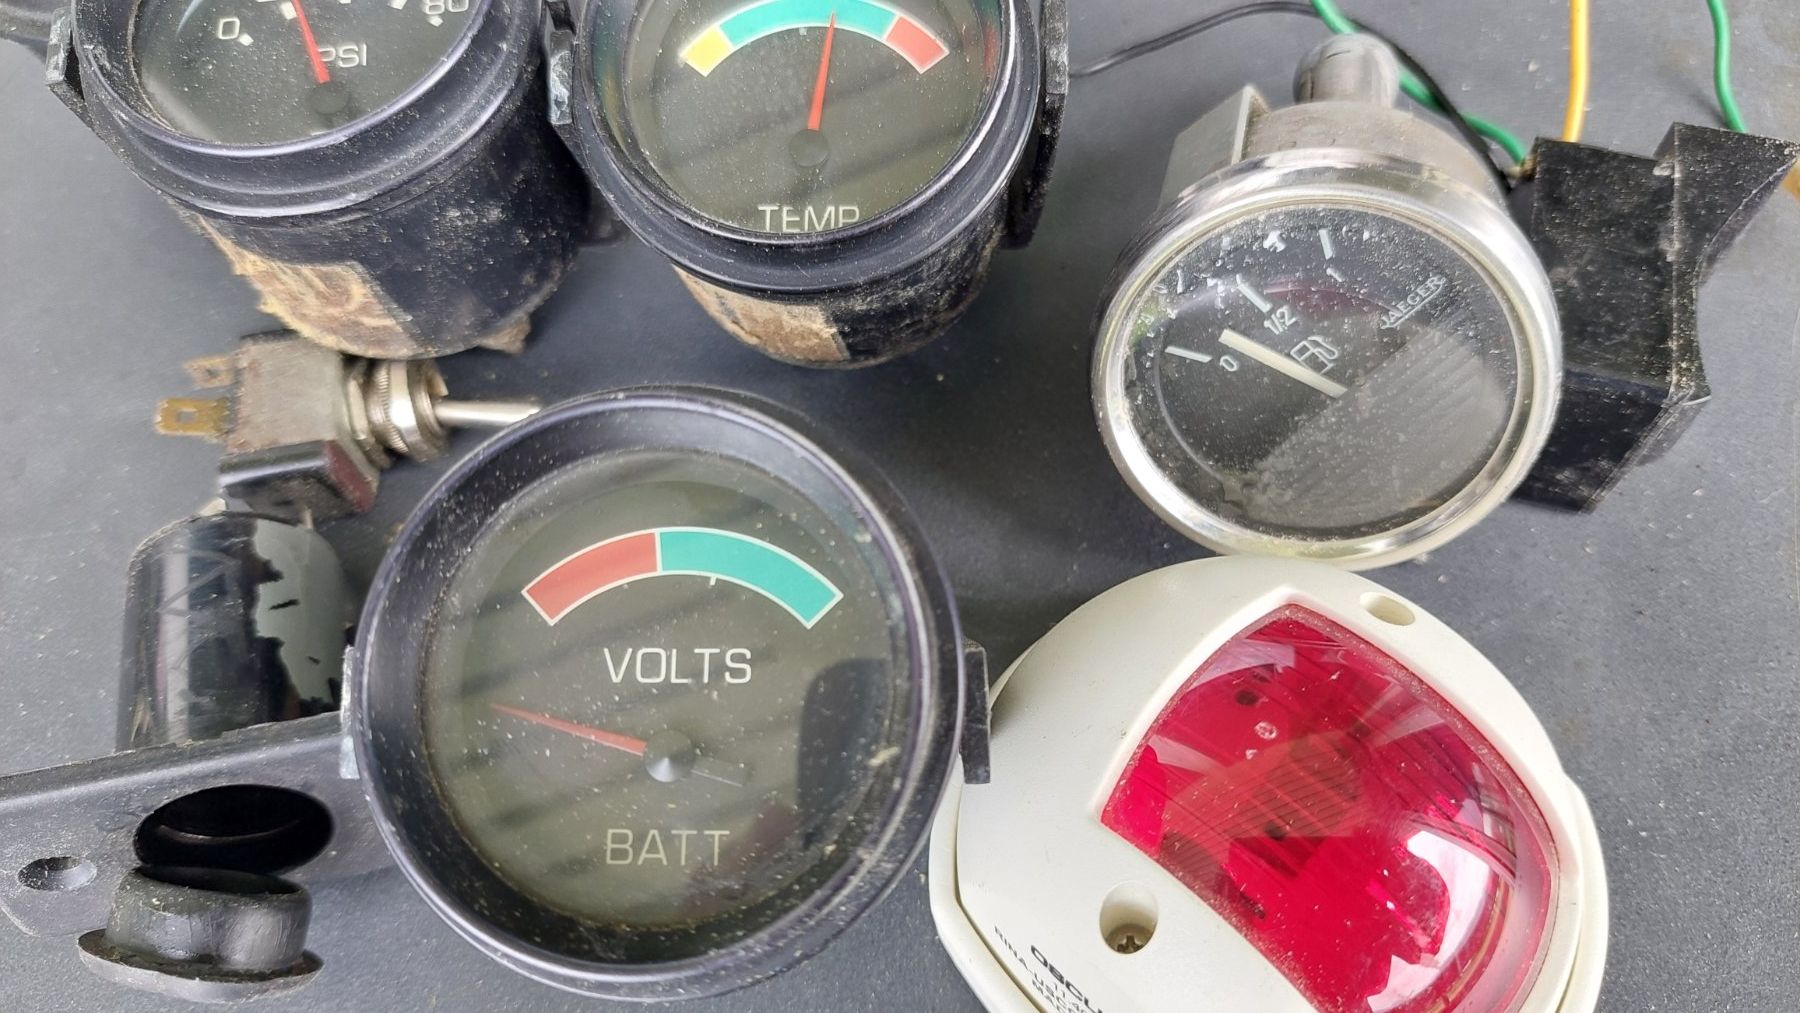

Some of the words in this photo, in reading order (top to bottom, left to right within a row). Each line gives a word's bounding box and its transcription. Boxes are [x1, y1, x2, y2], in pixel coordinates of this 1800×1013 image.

[217, 17, 240, 40] 0
[317, 42, 368, 69] PSI
[757, 204, 860, 233] TEMP
[1380, 275, 1446, 330] JAEGER
[1263, 304, 1298, 335] 1/2
[603, 647, 752, 684] VOLTS
[605, 828, 730, 866] BATT
